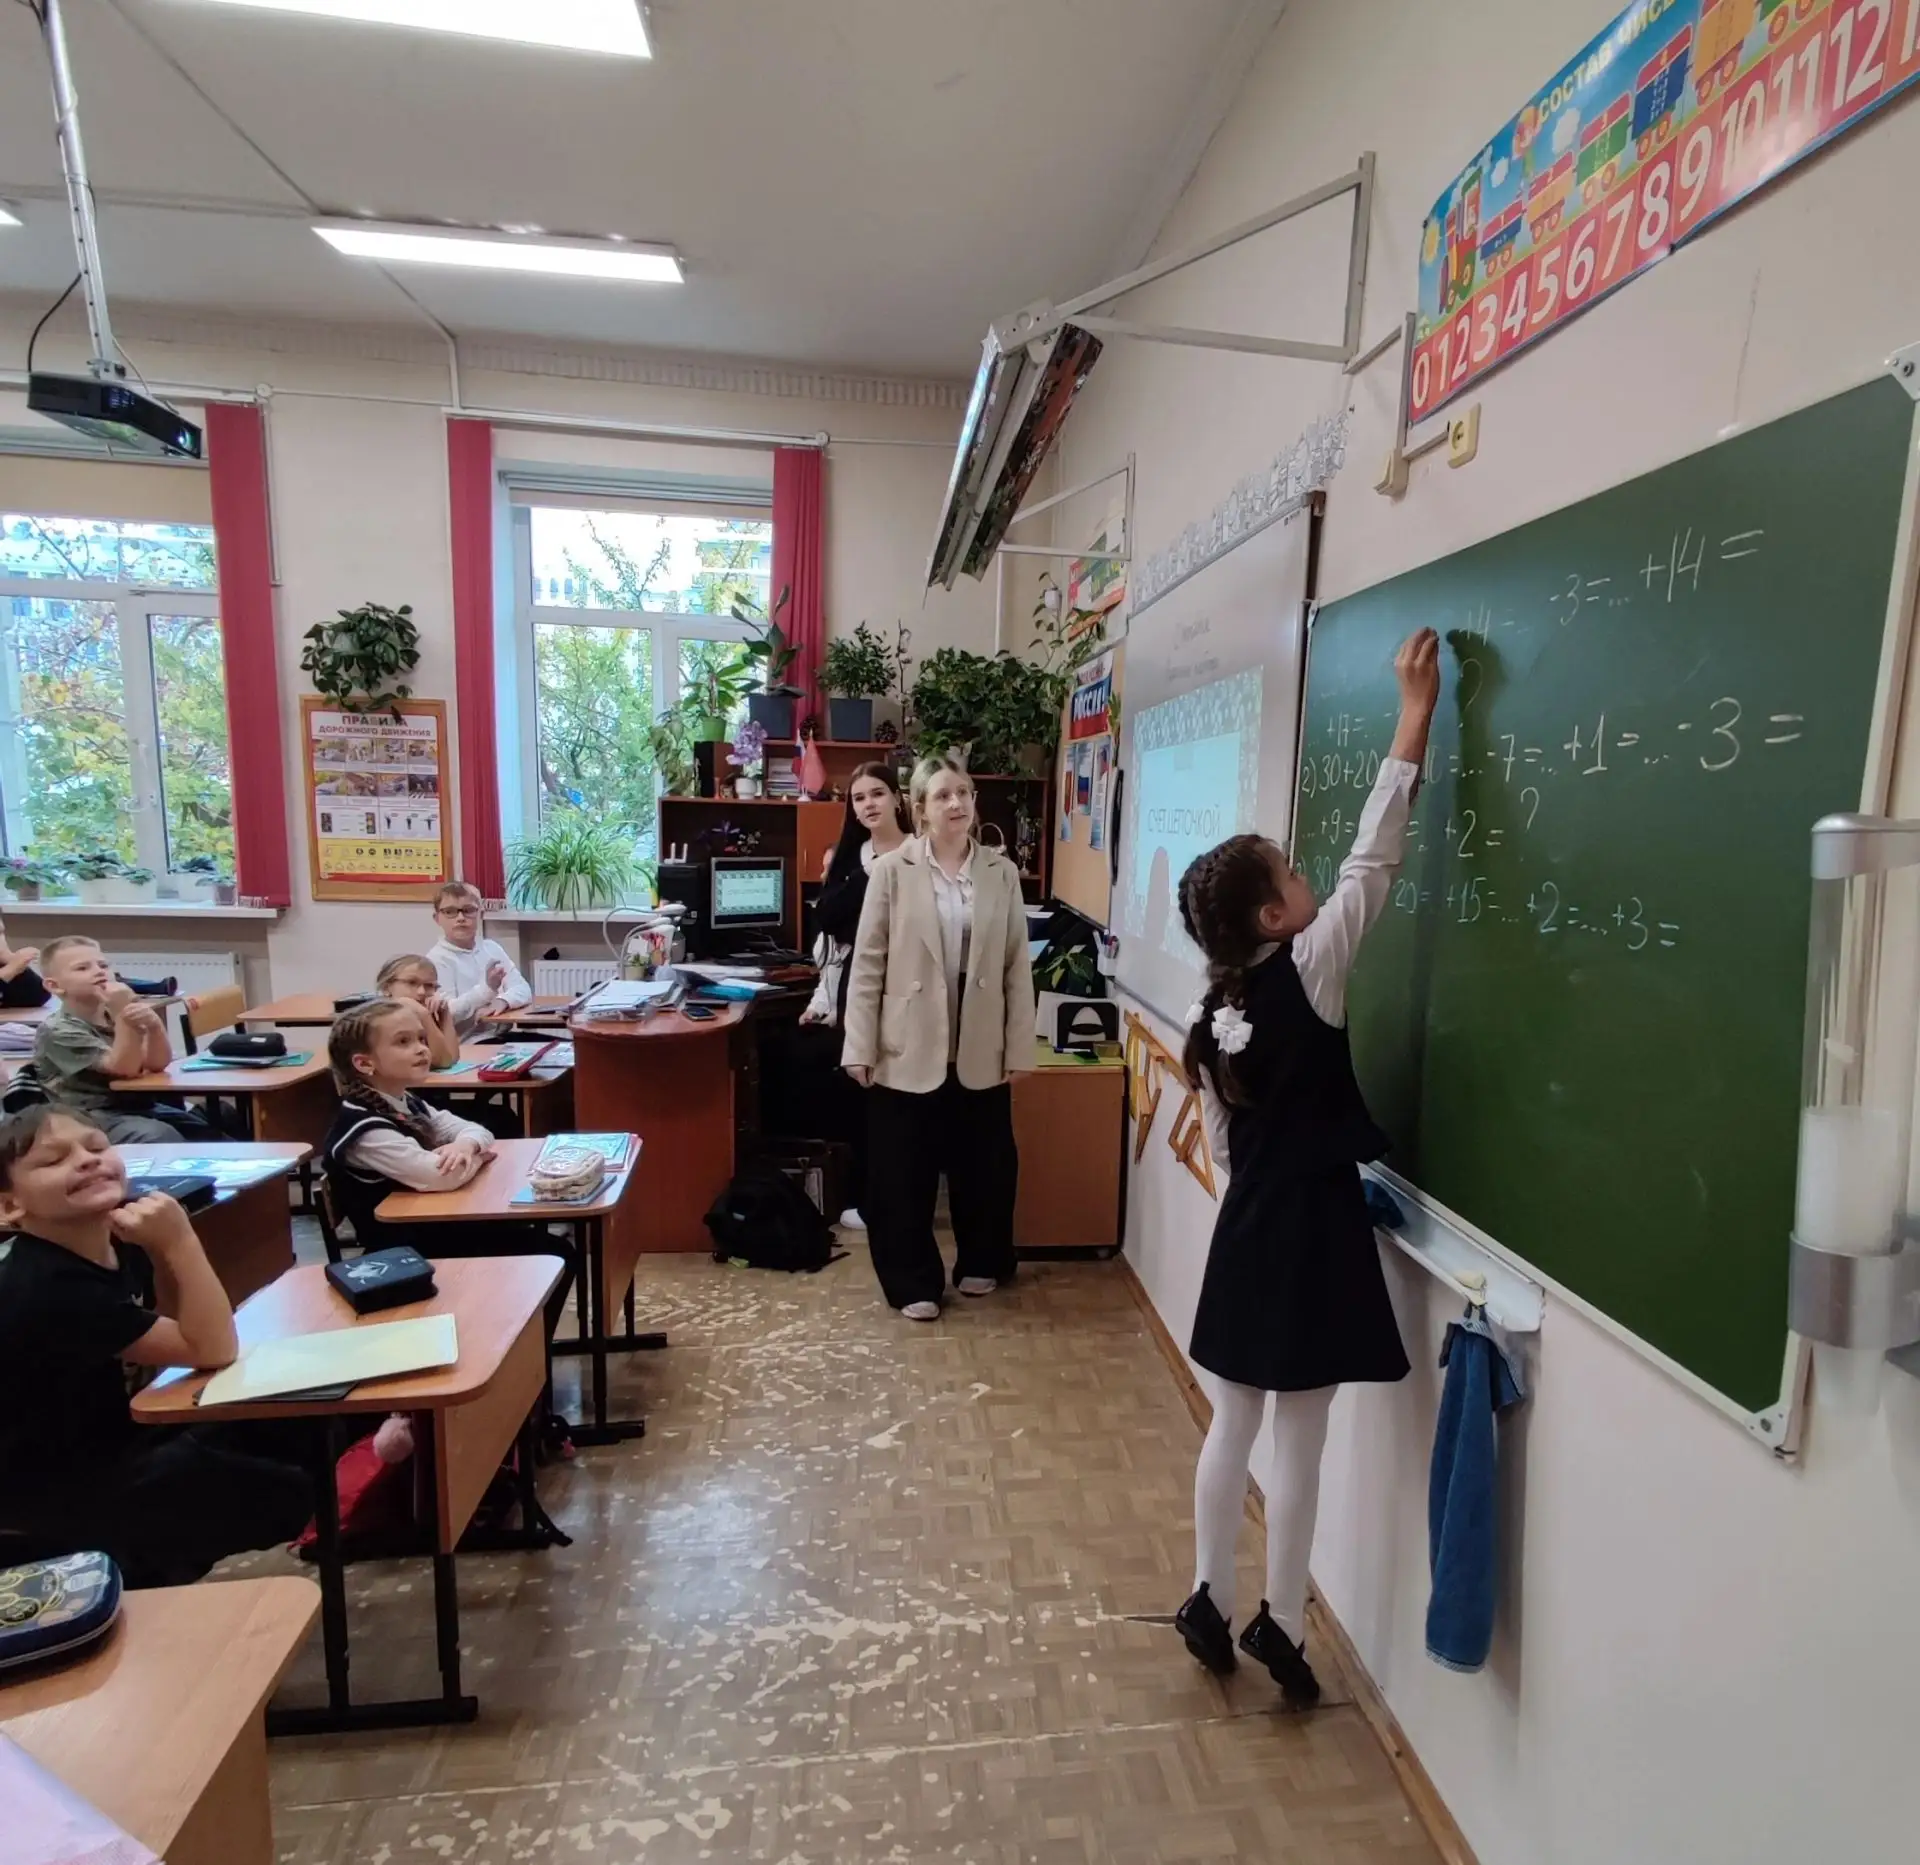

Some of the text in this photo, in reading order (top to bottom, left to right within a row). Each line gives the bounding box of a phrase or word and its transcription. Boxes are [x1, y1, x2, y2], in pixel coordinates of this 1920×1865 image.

[1539, 39, 1613, 124] СОСТАВ
[1412, 351, 1430, 409] 0
[1436, 332, 1449, 392] 1
[1451, 314, 1470, 381] 2
[1473, 293, 1498, 362] 3
[1502, 270, 1528, 339] 4
[1532, 246, 1561, 325] 5
[1566, 218, 1596, 300] 6
[1601, 189, 1635, 281] 7
[1638, 160, 1670, 250] 8
[1680, 125, 1712, 223] 9
[1720, 79, 1766, 191] 10
[1773, 31, 1823, 148] 11
[1830, 0, 1893, 112] 12
[381, 727, 431, 738] ДВИЖЕНИЯ
